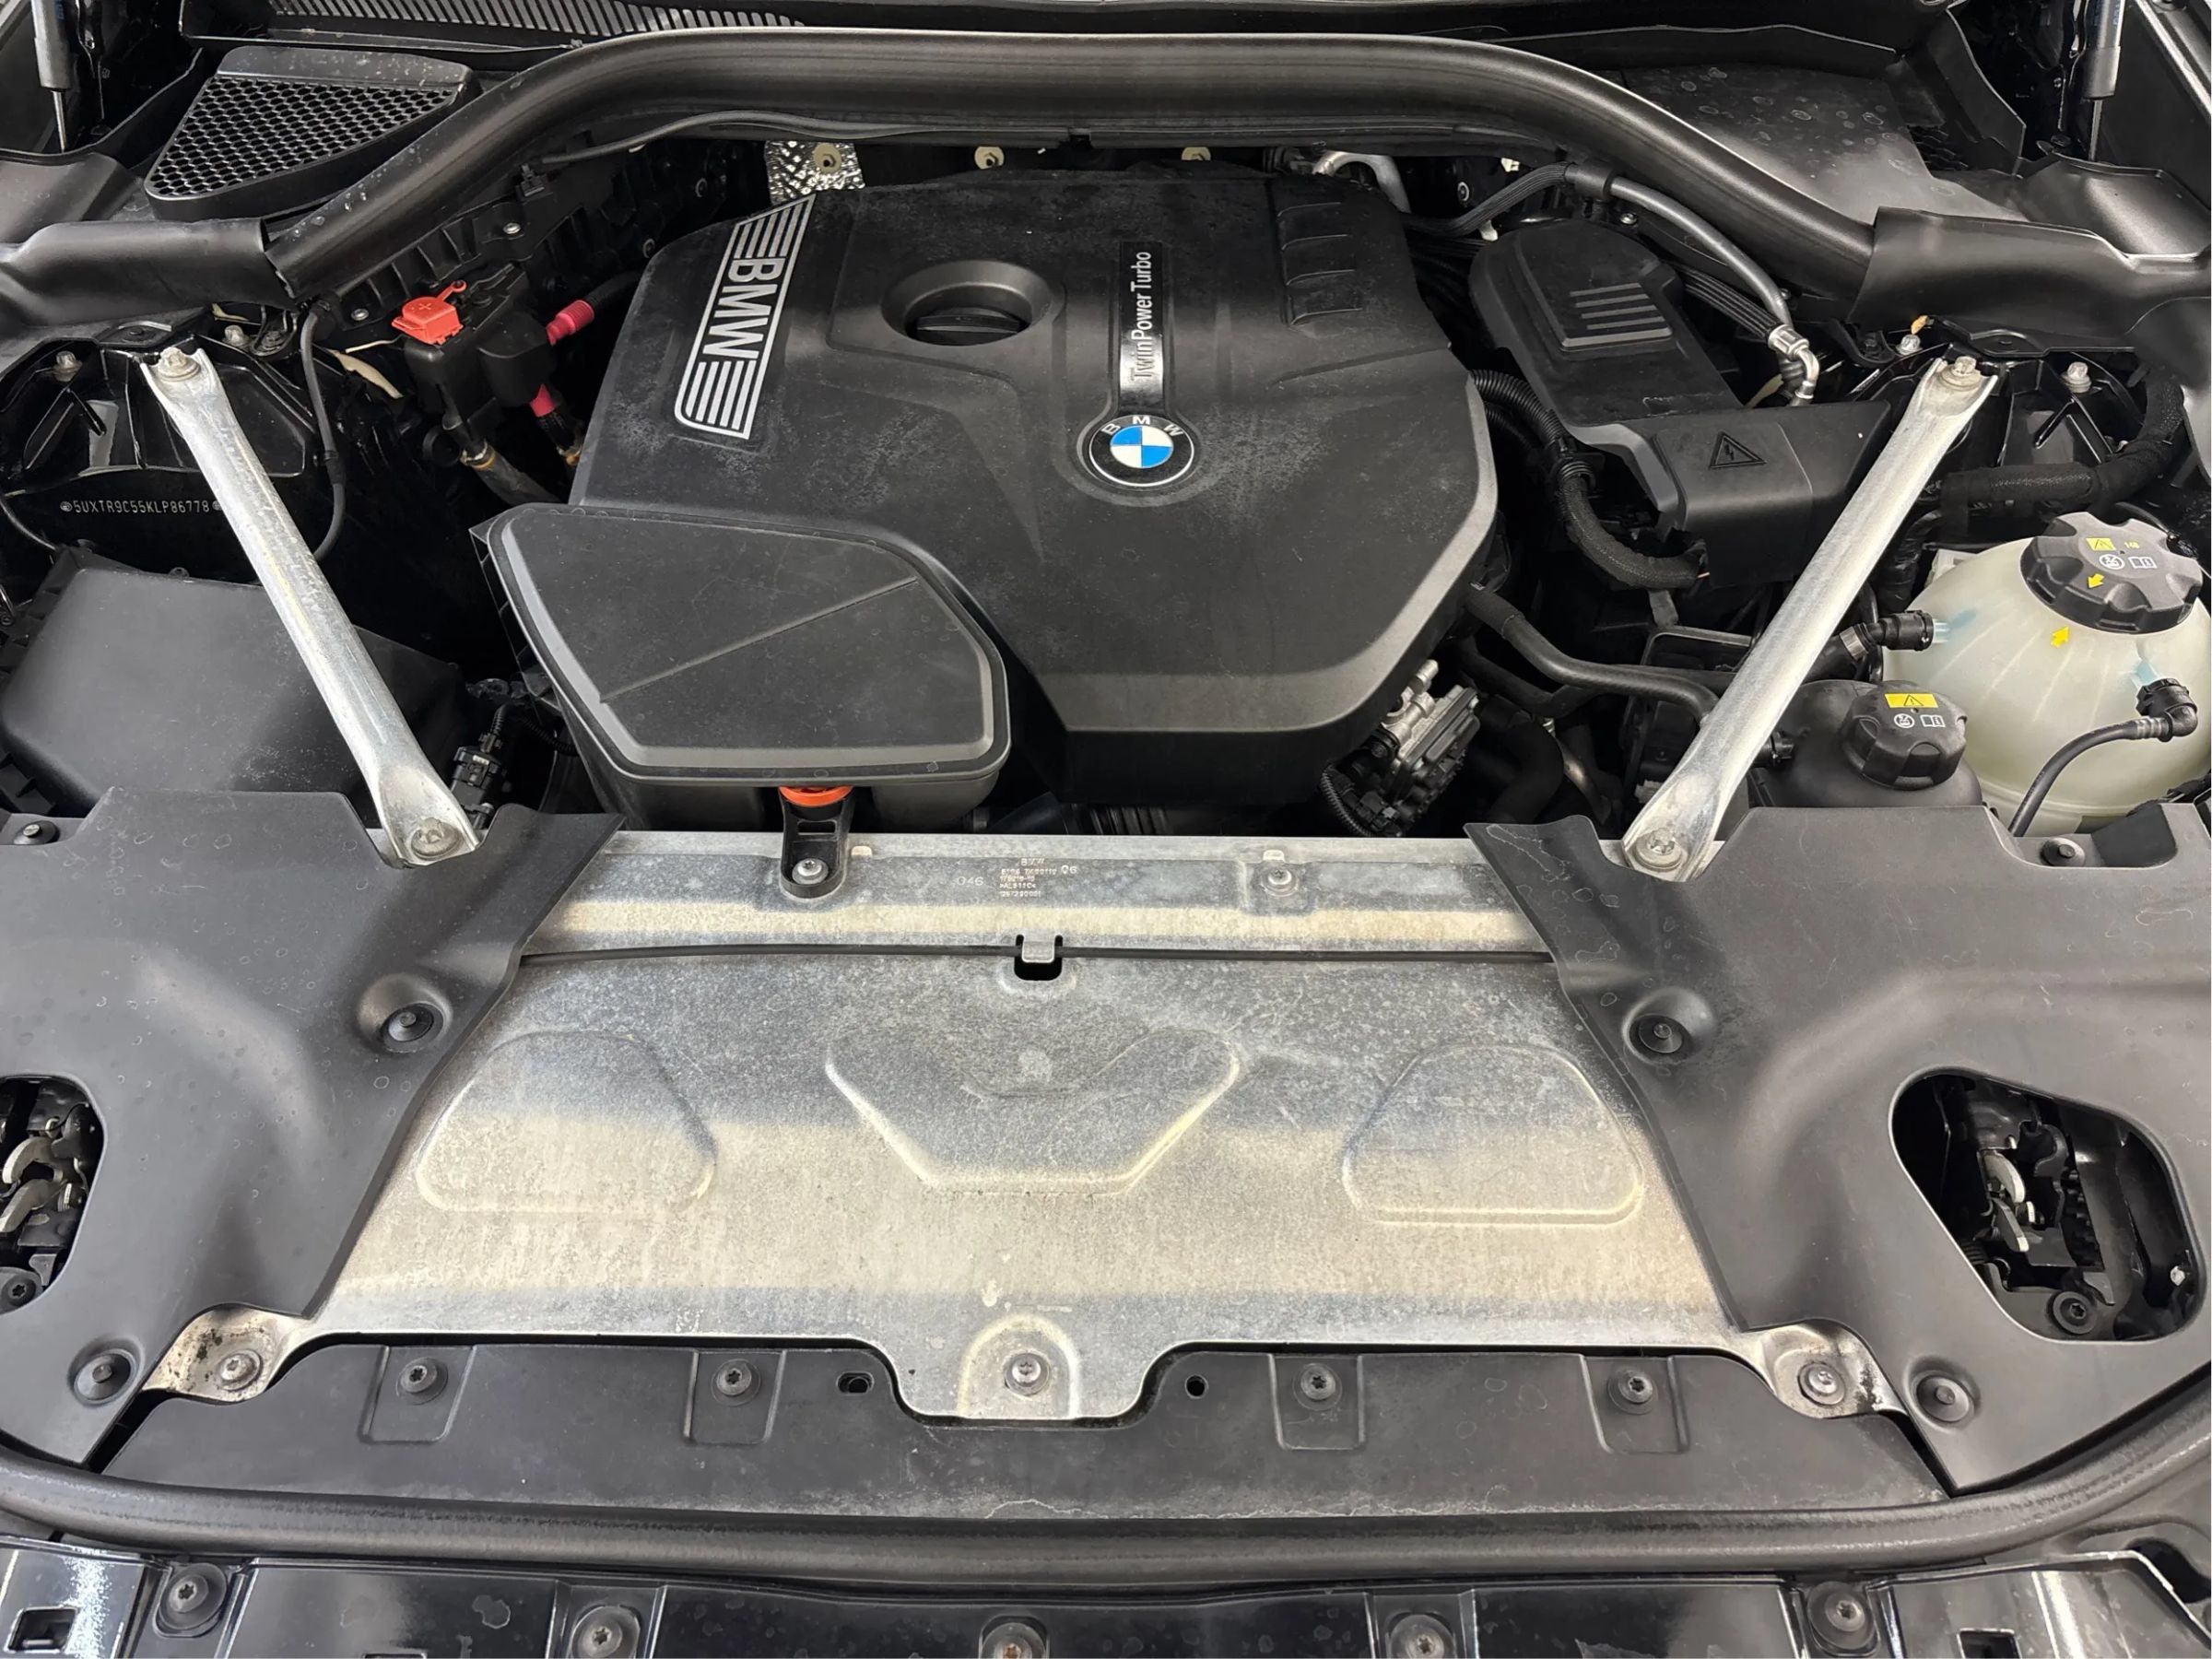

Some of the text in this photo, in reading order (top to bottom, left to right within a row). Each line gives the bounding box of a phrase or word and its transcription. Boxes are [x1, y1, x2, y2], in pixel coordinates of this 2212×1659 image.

[702, 258, 786, 359] BMW
[1130, 251, 1153, 382] TwinPower Turbo
[1100, 415, 1184, 437] BMW
[73, 500, 210, 513] 5UXTR9C55KLP86778
